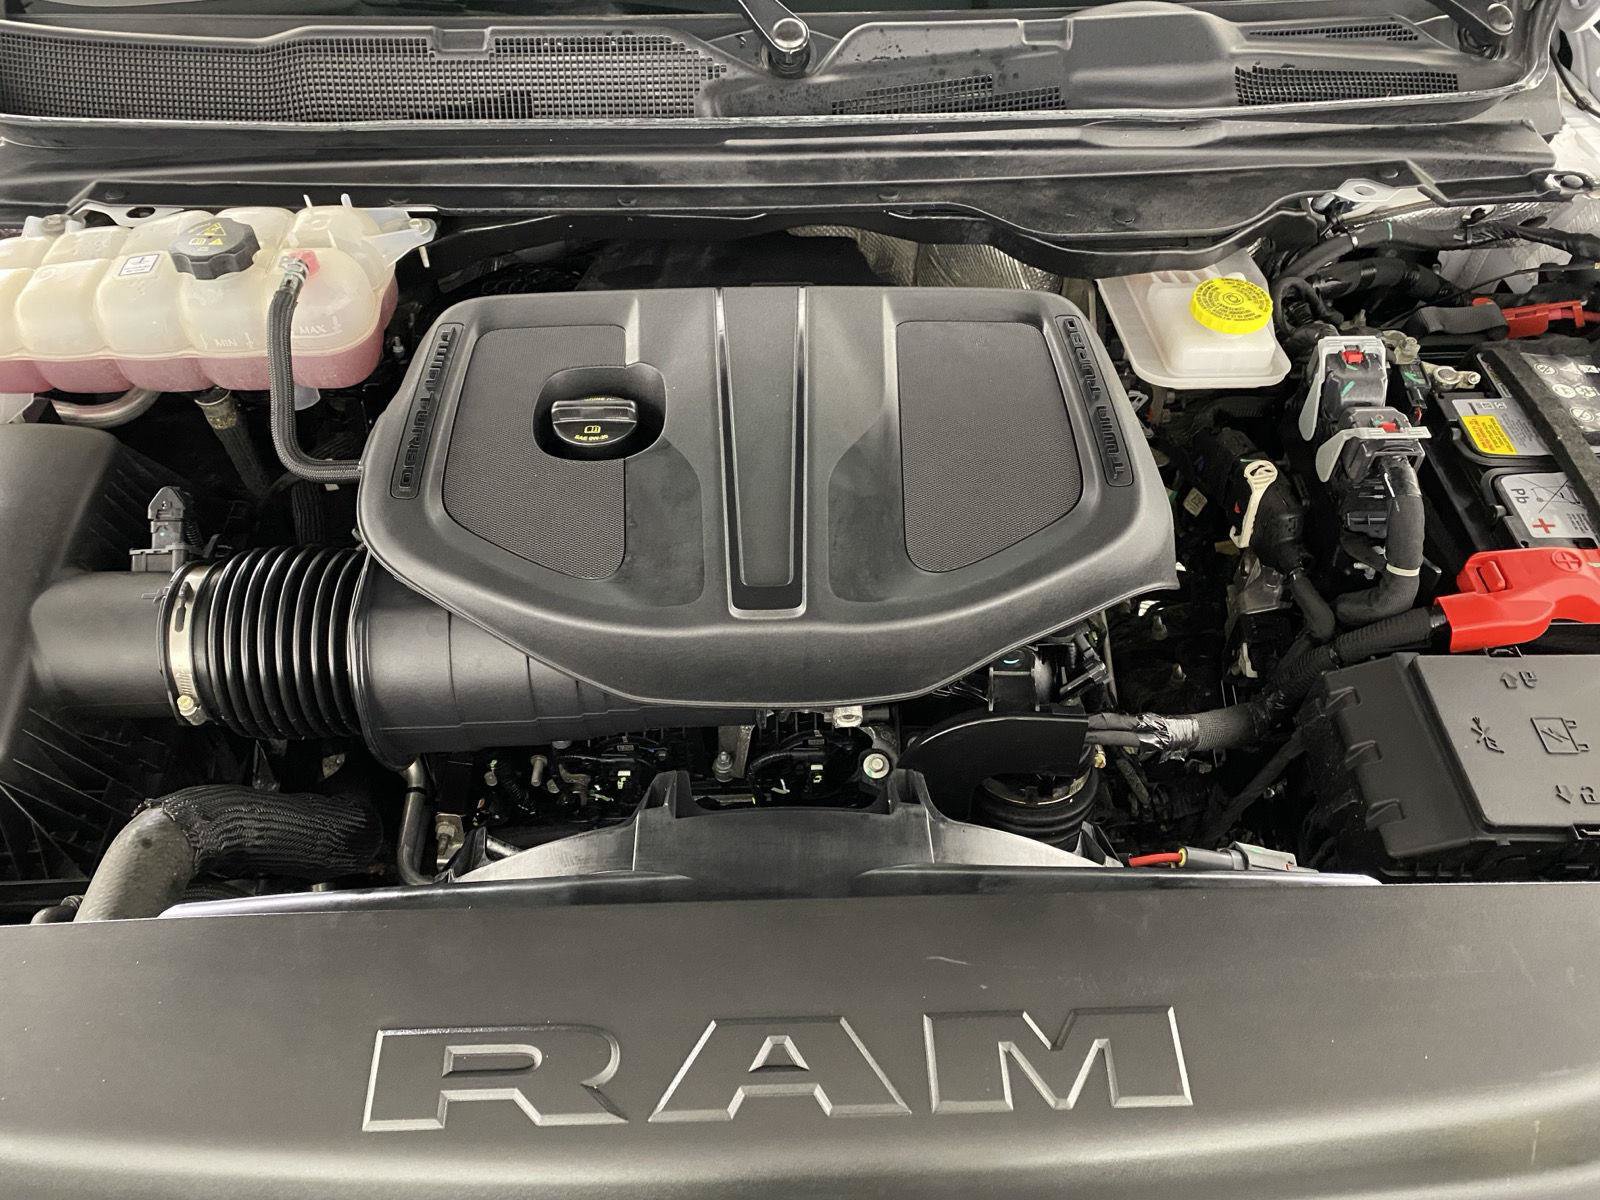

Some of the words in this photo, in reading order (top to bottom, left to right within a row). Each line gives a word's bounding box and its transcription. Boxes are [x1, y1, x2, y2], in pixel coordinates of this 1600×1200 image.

[214, 337, 238, 348] MIN
[300, 324, 330, 335] MAX
[424, 326, 458, 391] TWIN
[1063, 318, 1101, 401] TURBO
[399, 391, 436, 489] TURBO
[1095, 405, 1125, 480] TWIN
[1511, 488, 1530, 504] Pb
[362, 1005, 1194, 1133] RAM
